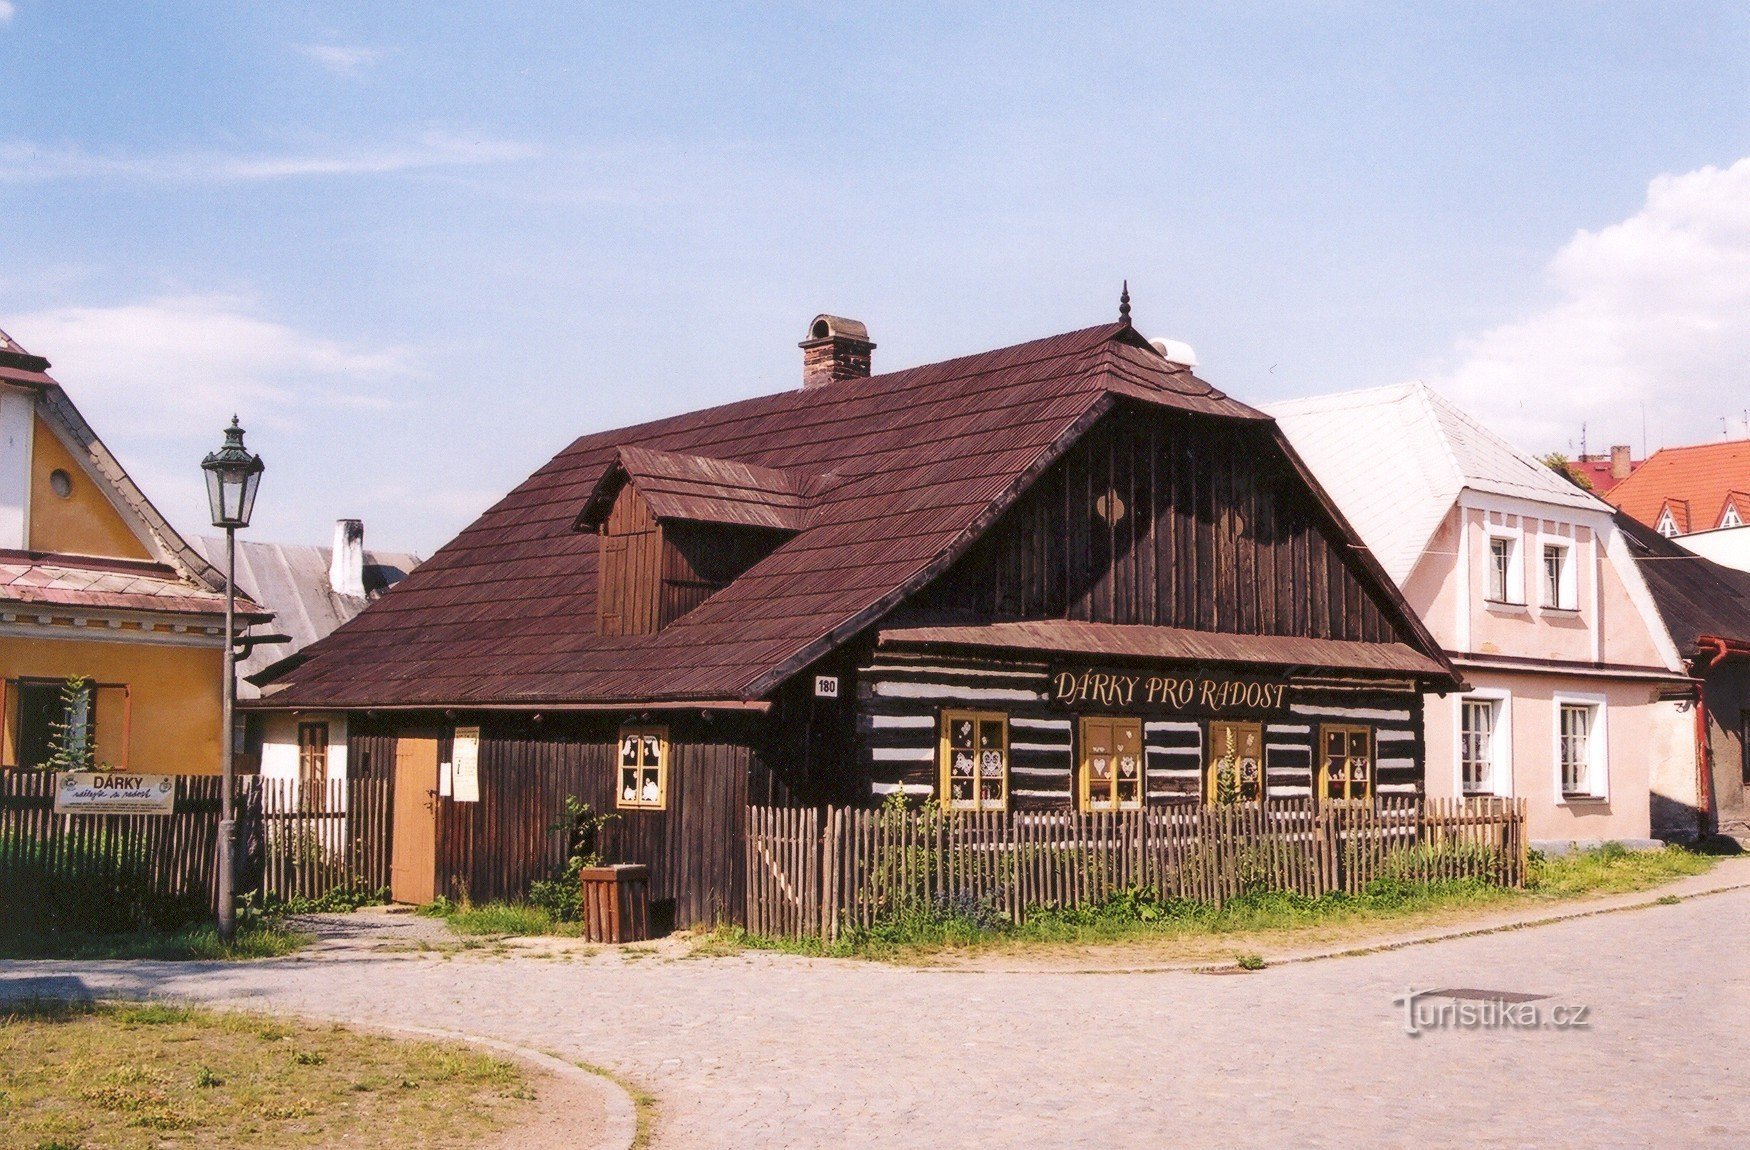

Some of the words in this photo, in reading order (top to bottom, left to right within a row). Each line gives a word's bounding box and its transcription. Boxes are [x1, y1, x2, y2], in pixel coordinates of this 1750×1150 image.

[818, 680, 836, 693] 180
[1054, 669, 1139, 705] DÁRKY
[1145, 677, 1194, 709] PRO
[1199, 680, 1288, 710] RADOST
[93, 774, 143, 790] DÁRKY
